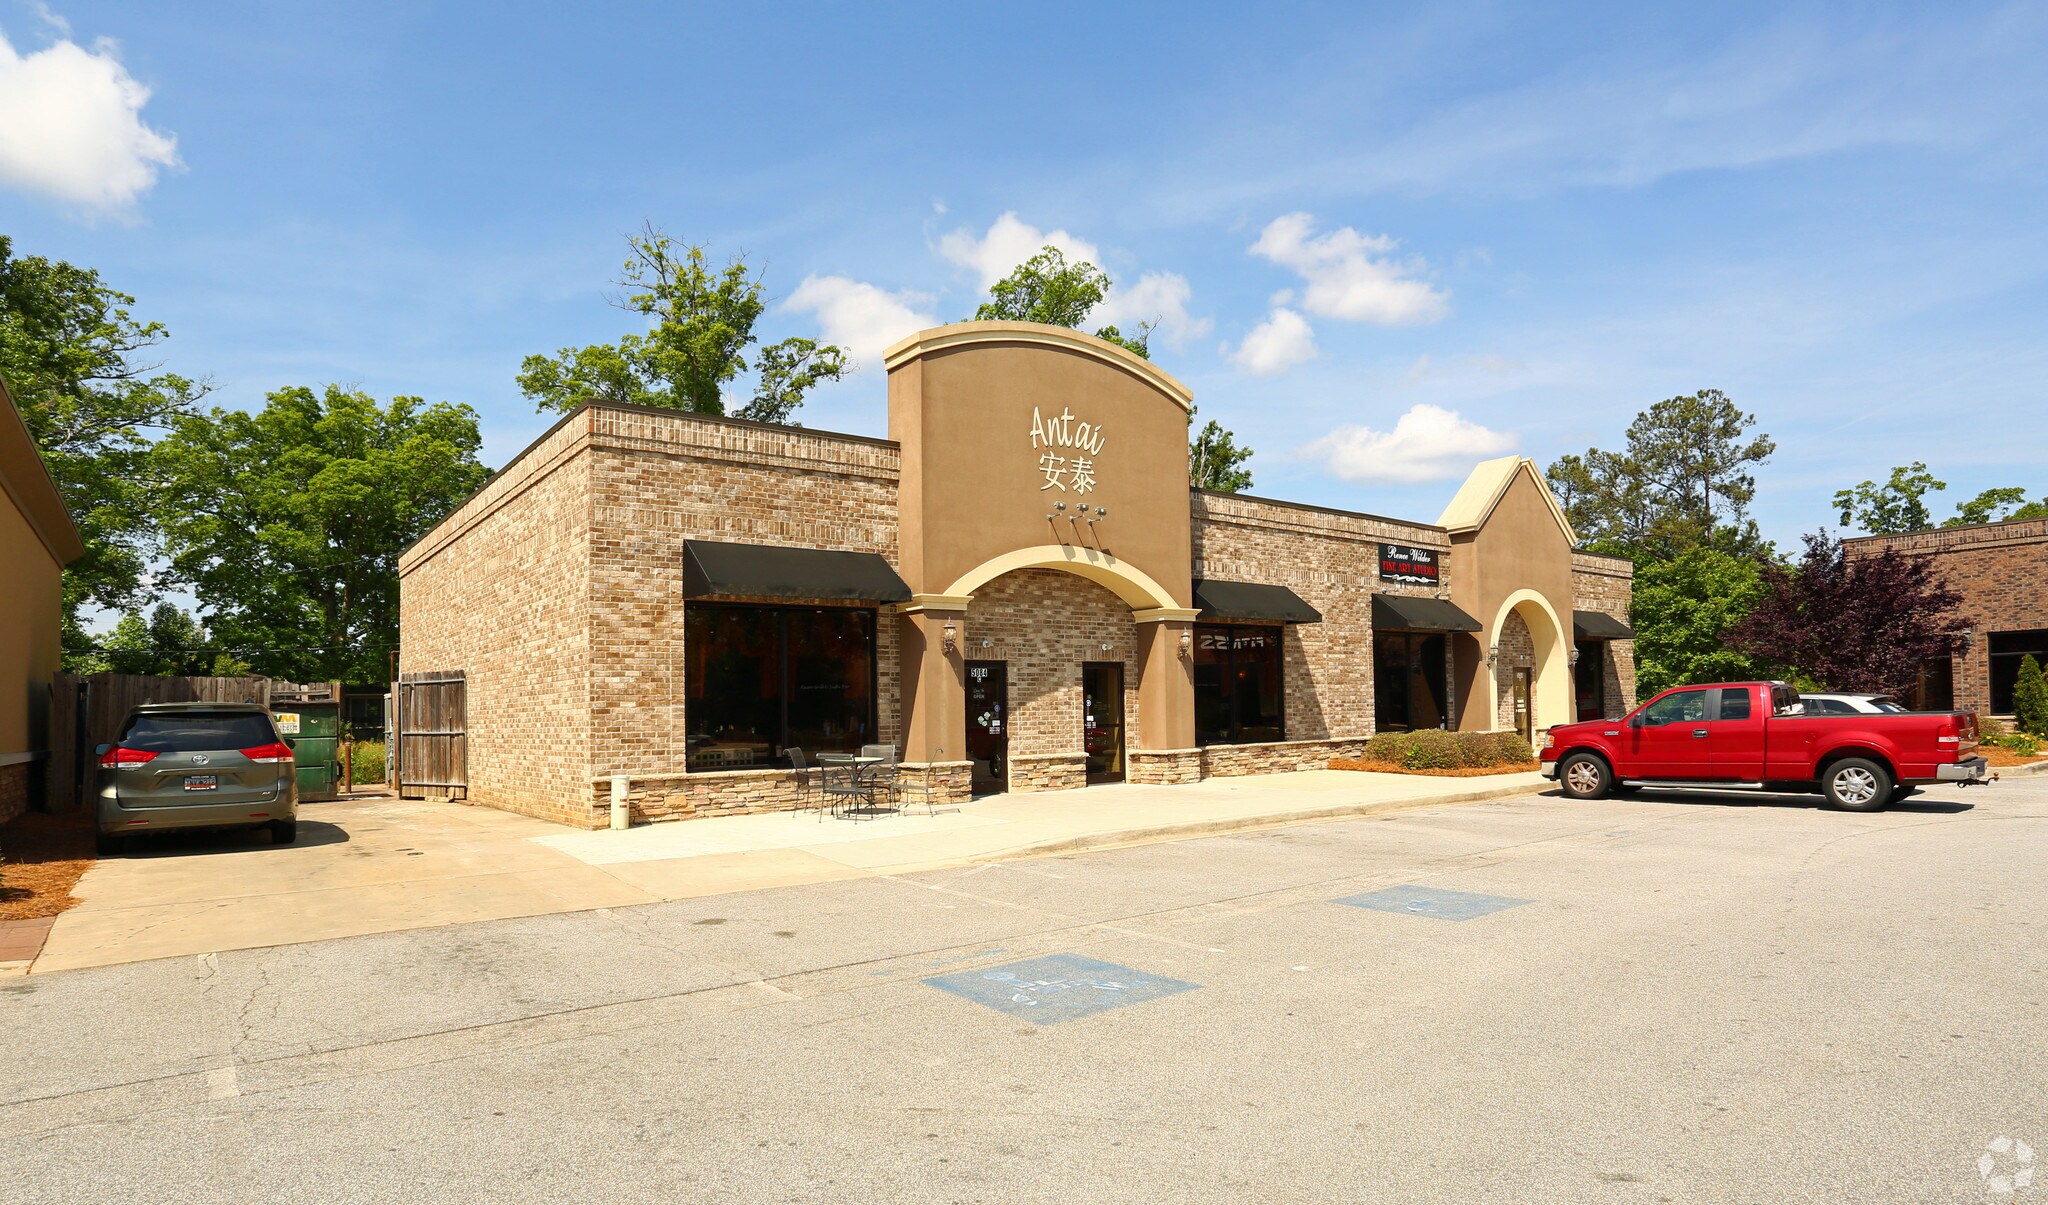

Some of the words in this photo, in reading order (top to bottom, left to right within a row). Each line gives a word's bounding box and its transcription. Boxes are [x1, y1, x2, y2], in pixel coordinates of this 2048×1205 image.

[1030, 406, 1105, 456] Antai
[1039, 451, 1097, 495] 安泰
[1382, 561, 1396, 571] FINE
[1398, 563, 1411, 573] ART
[1413, 564, 1436, 576] STUDIO
[1410, 549, 1431, 562] Wilder
